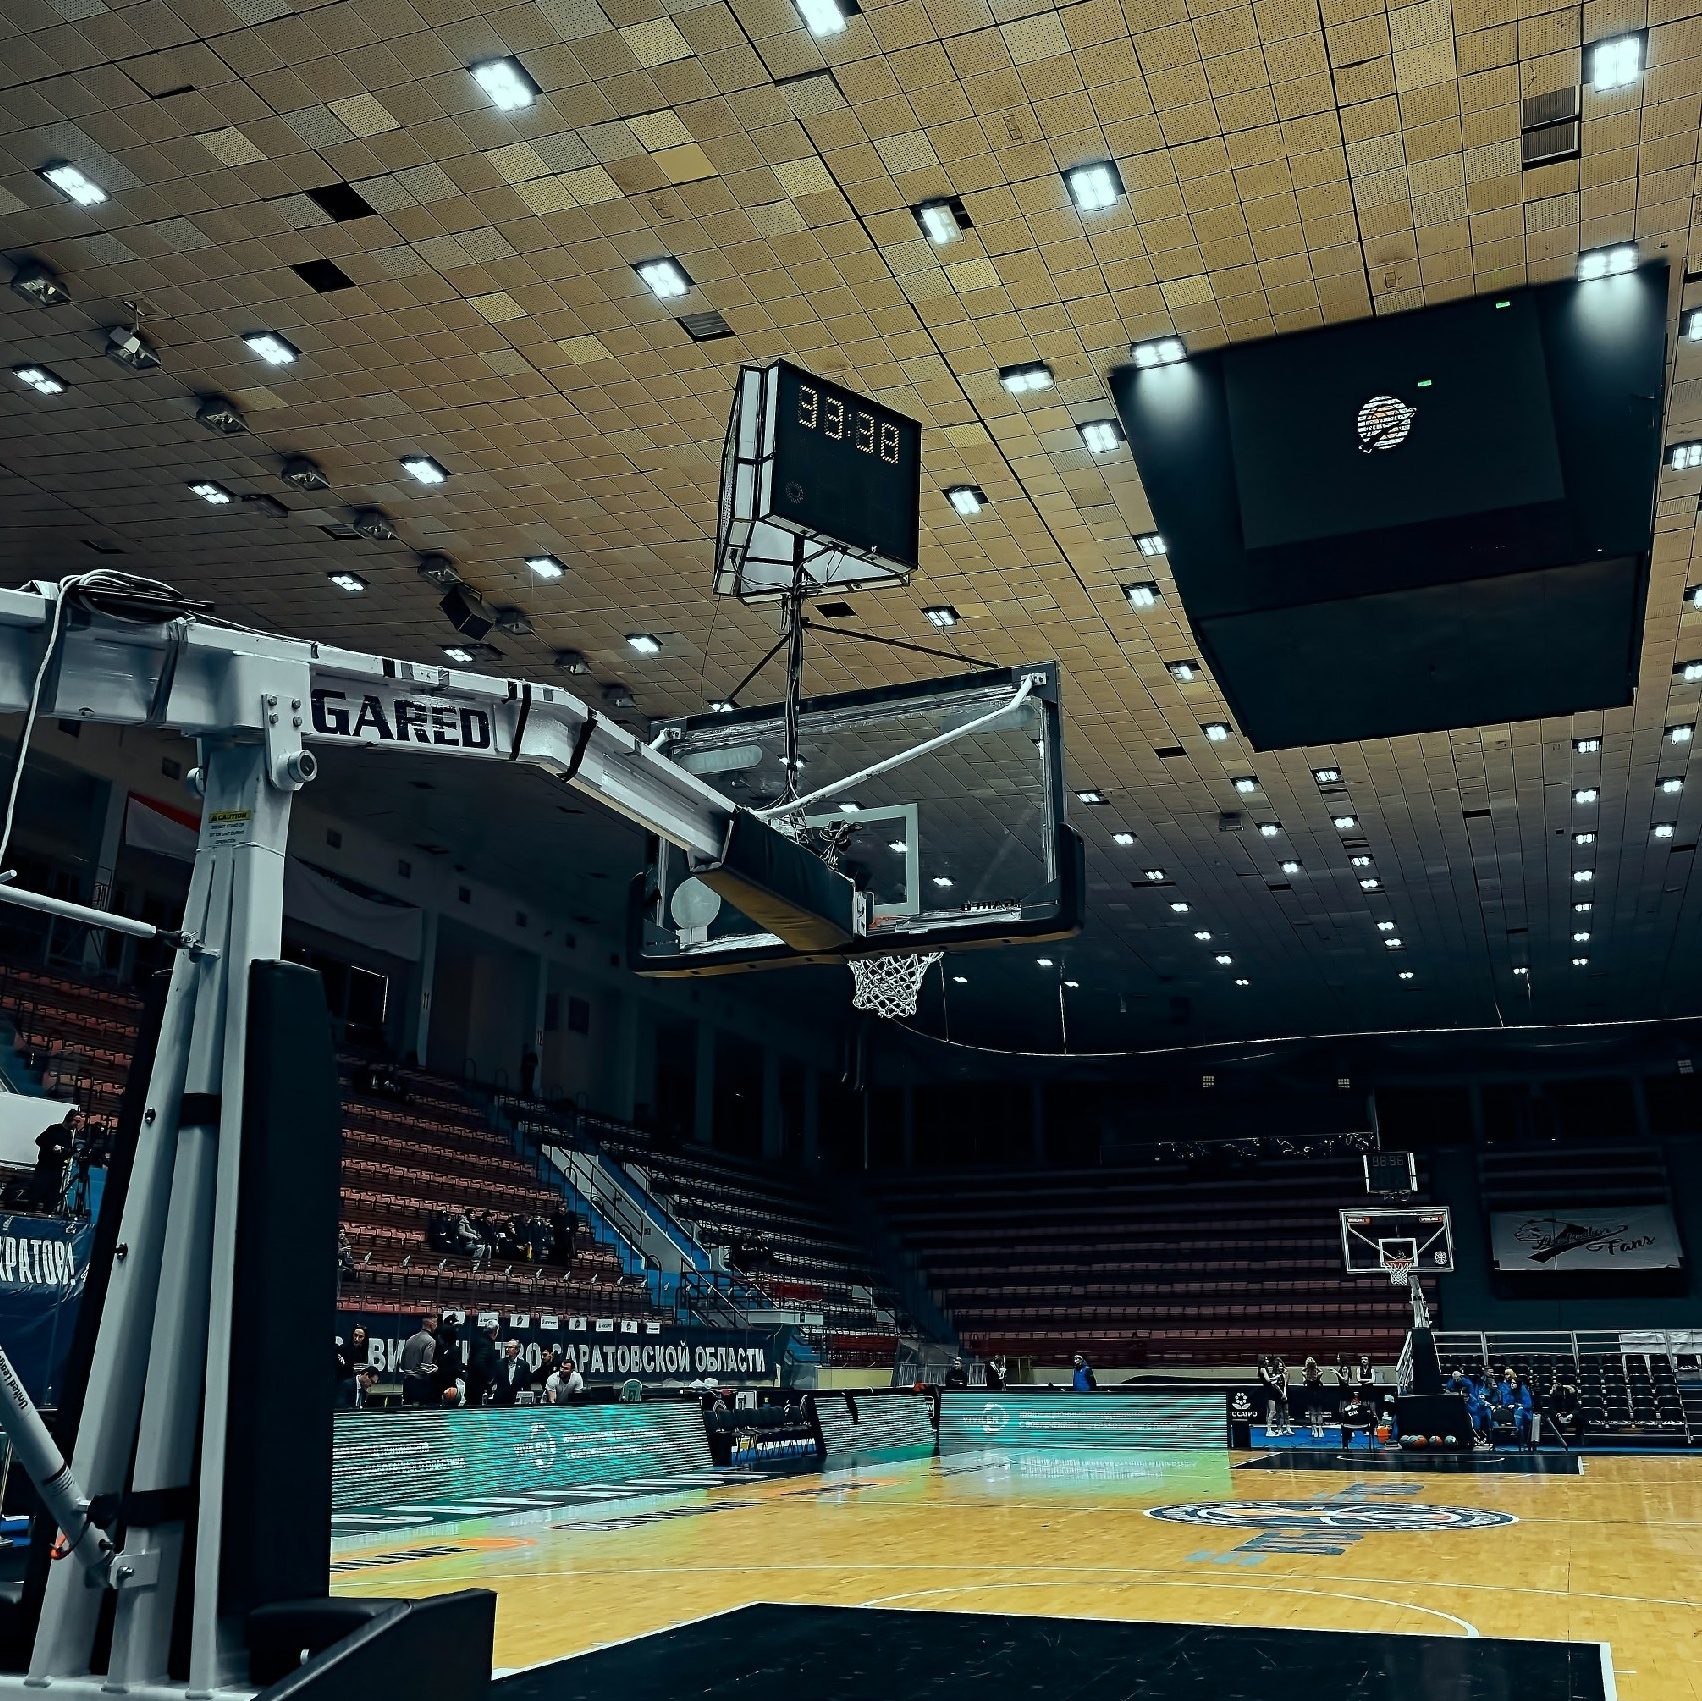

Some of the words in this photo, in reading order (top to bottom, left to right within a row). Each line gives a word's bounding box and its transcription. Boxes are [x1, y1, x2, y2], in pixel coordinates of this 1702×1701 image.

[311, 689, 490, 749] GARED
[217, 812, 247, 821] CAUTION
[695, 1346, 766, 1373] ОБЛАСТИ
